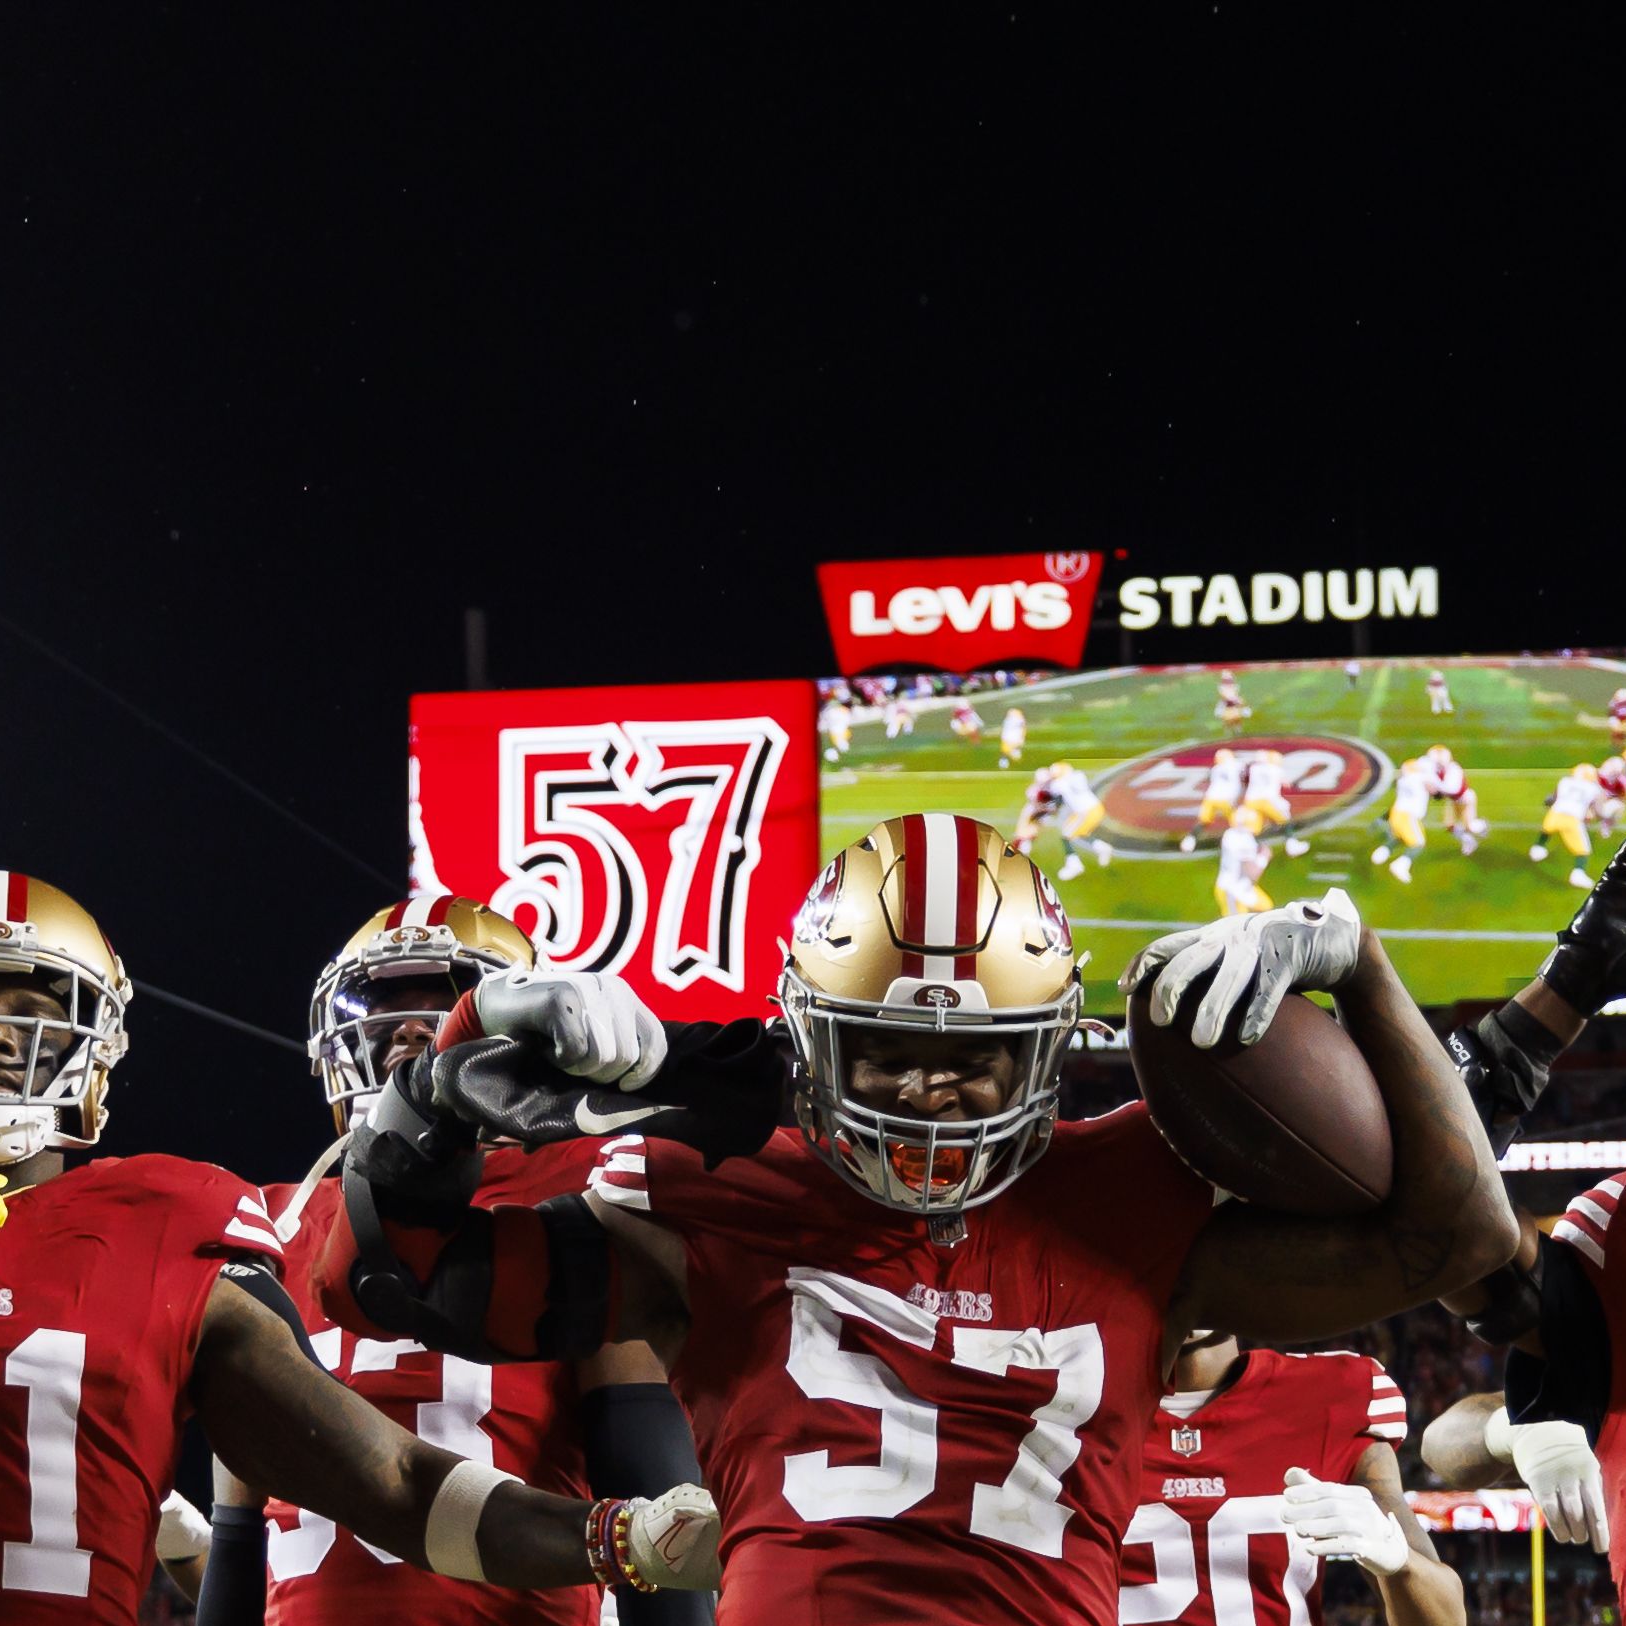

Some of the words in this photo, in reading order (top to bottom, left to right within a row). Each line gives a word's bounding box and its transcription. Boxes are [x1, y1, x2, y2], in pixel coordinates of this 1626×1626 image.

[1118, 566, 1439, 630] STADIUM
[488, 716, 790, 992] 57
[782, 1265, 1105, 1559] 57
[1161, 1476, 1227, 1499] 49ERS
